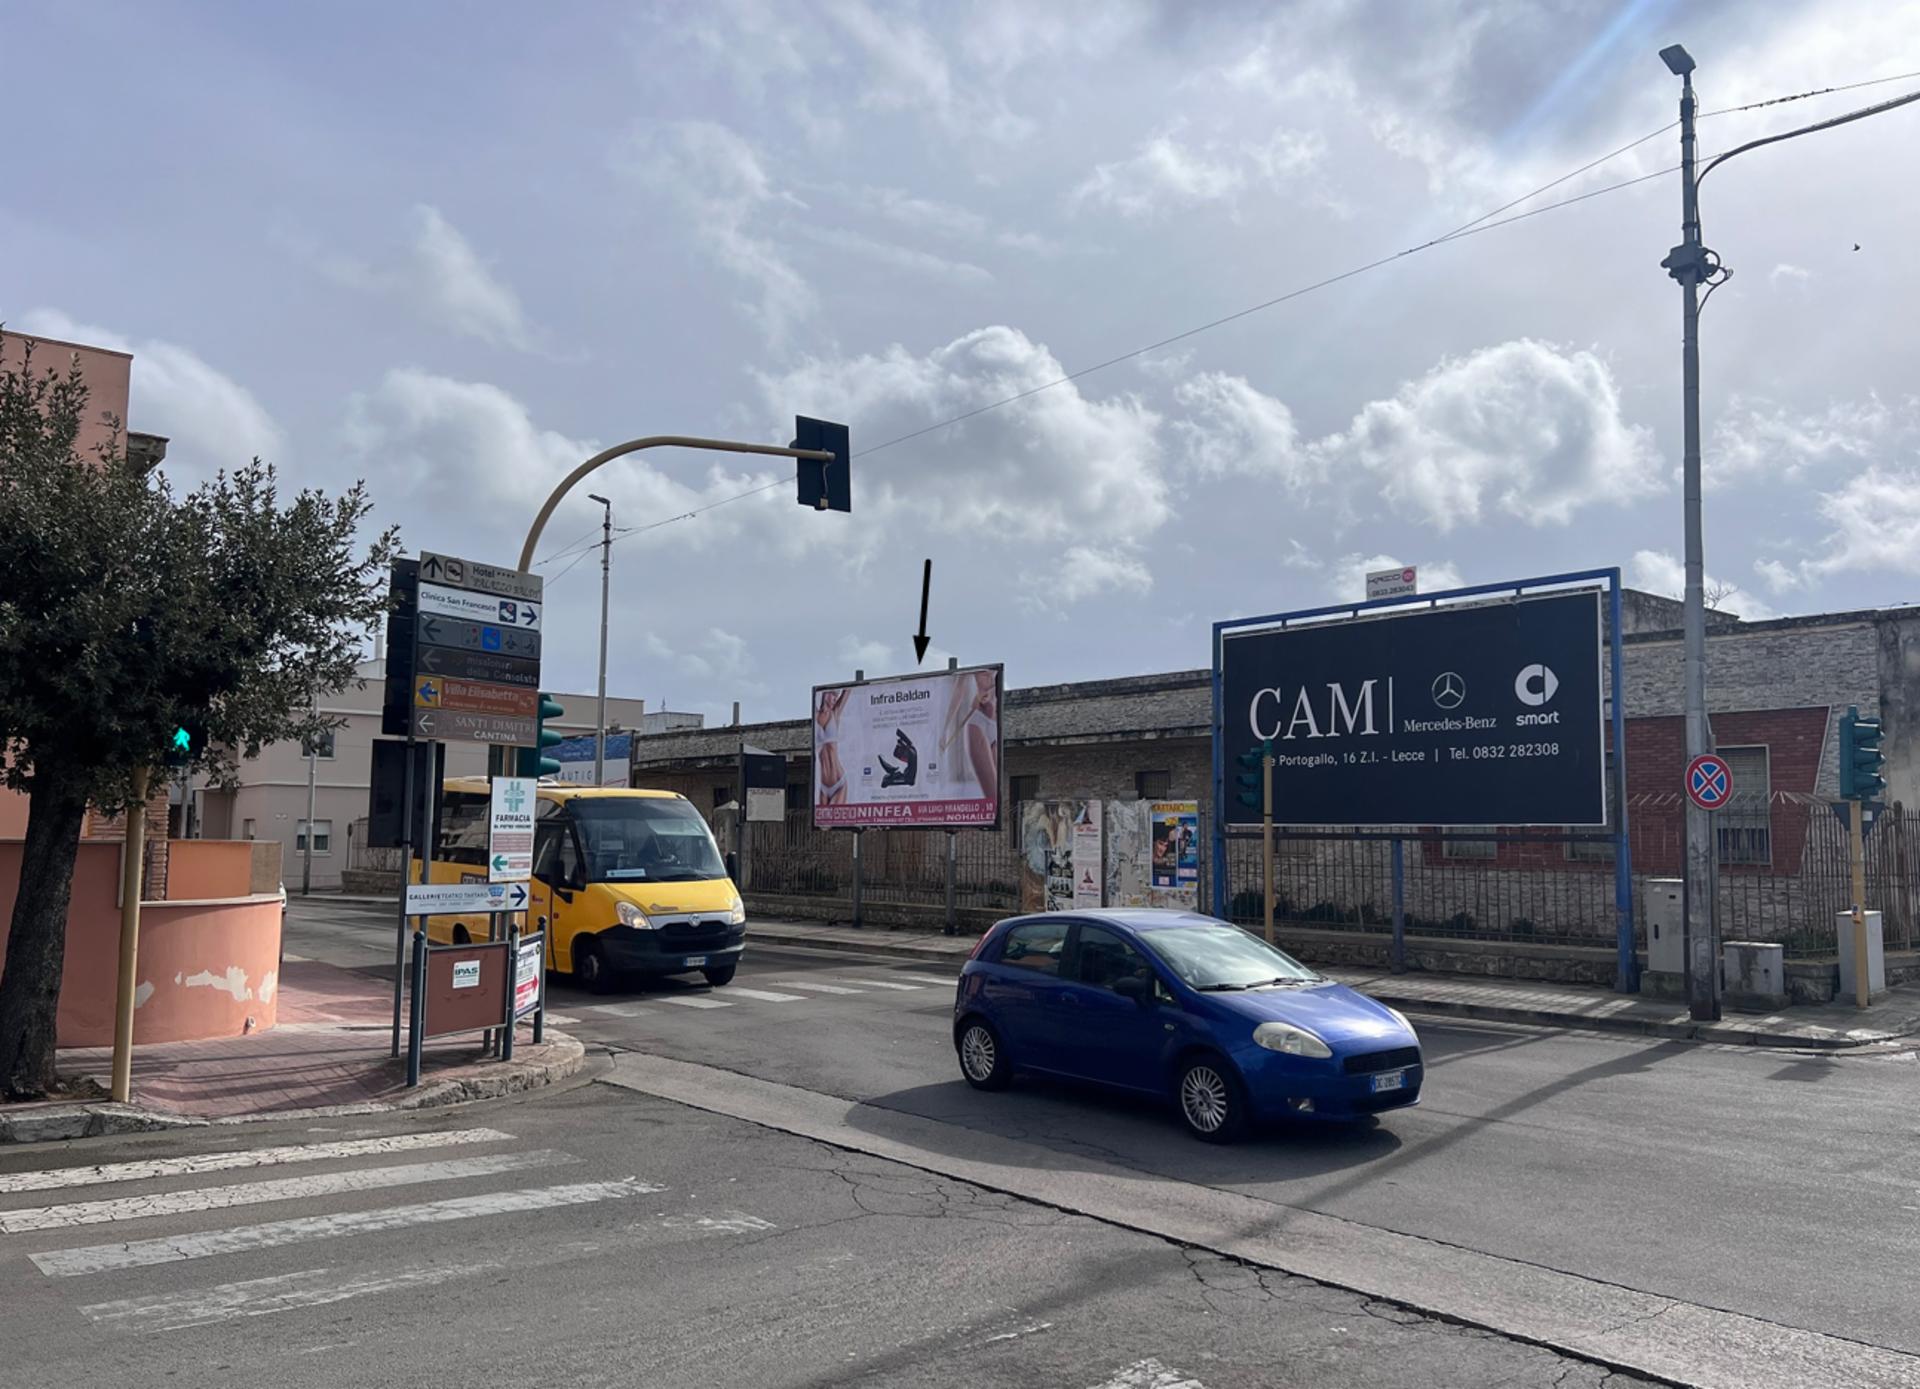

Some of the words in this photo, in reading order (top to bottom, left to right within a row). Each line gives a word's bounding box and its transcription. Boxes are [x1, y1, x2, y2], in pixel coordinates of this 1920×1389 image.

[472, 566, 495, 578] Hotel
[421, 591, 446, 602] Clinica
[447, 596, 460, 605] San
[462, 599, 497, 612] Francesco
[467, 686, 519, 701] Elisabetta
[1249, 679, 1380, 741] CAM
[455, 716, 488, 728] SANTI
[1403, 716, 1497, 733] Mercedes-Benz
[1516, 711, 1560, 727] smart
[473, 730, 517, 742] CANTINA
[1279, 752, 1339, 769] Portogallo,
[1343, 752, 1356, 764] 16
[1360, 751, 1379, 764] Z.I.
[1391, 749, 1425, 762] Lecce
[1449, 747, 1470, 760] Tel.
[1472, 745, 1505, 760] 0832
[1509, 742, 1560, 759] 282308
[495, 814, 531, 822] FARMACIA
[857, 805, 912, 818] NINFEA
